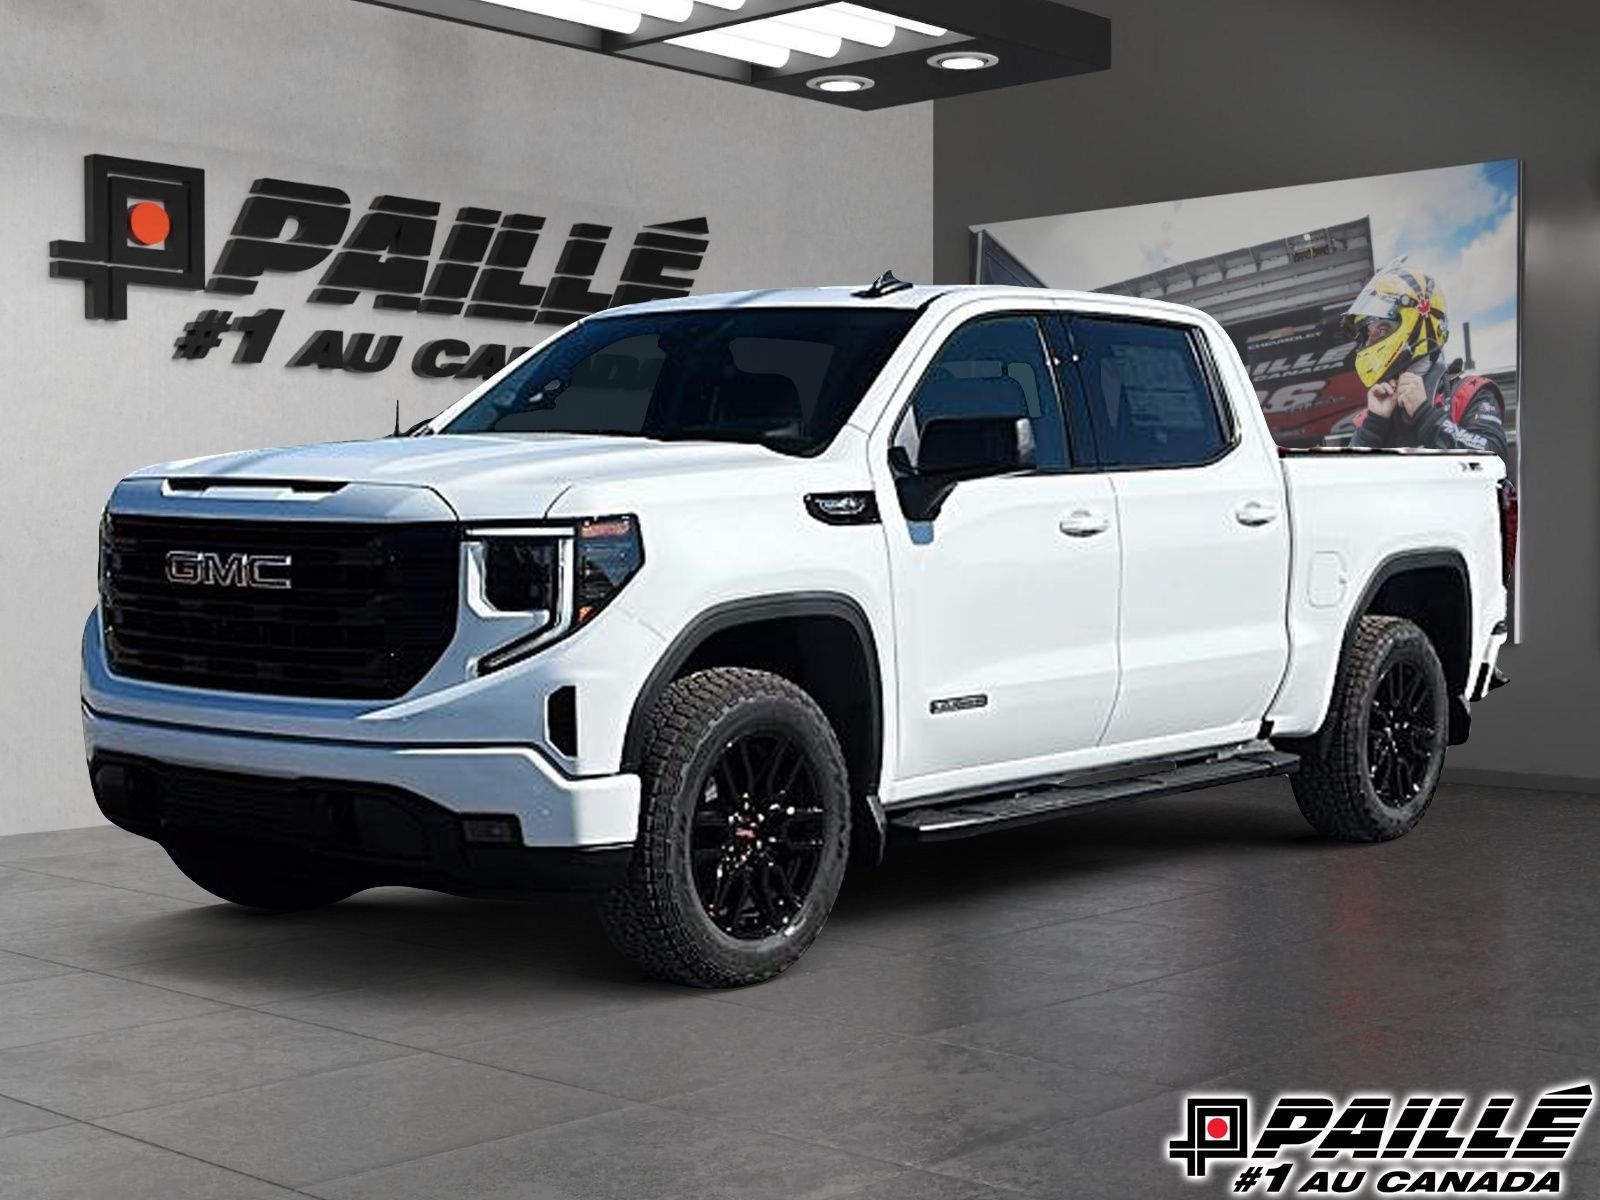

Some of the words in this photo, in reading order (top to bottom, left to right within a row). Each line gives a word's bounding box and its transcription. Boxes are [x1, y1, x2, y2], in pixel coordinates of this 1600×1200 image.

[205, 178, 709, 325] PAILLÉ
[172, 308, 286, 363] #1
[285, 330, 403, 373] AU
[1253, 361, 1344, 382] CANADA
[165, 550, 292, 589] GMC
